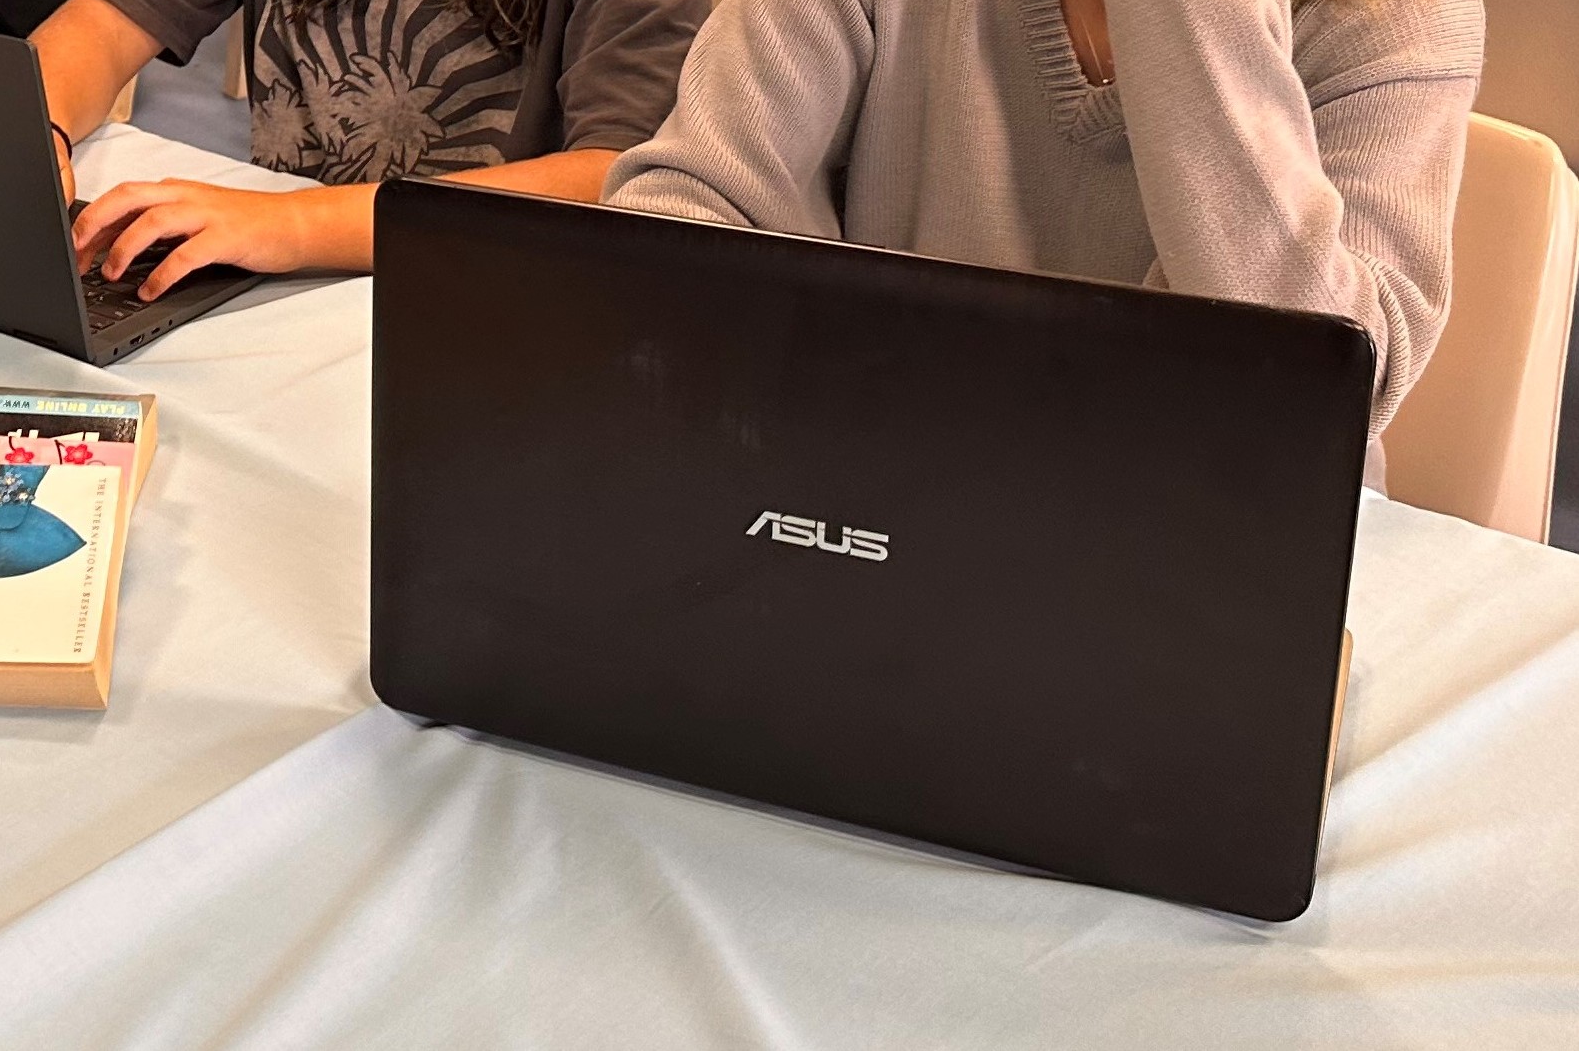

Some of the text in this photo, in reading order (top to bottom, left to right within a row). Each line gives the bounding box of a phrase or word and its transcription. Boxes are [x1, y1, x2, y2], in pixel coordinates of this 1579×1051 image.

[36, 400, 89, 413] ONLINE
[92, 404, 126, 415] PLAY
[745, 510, 890, 562] ASUS
[73, 477, 107, 653] THE INTERNATIONAL BESTSELLER
